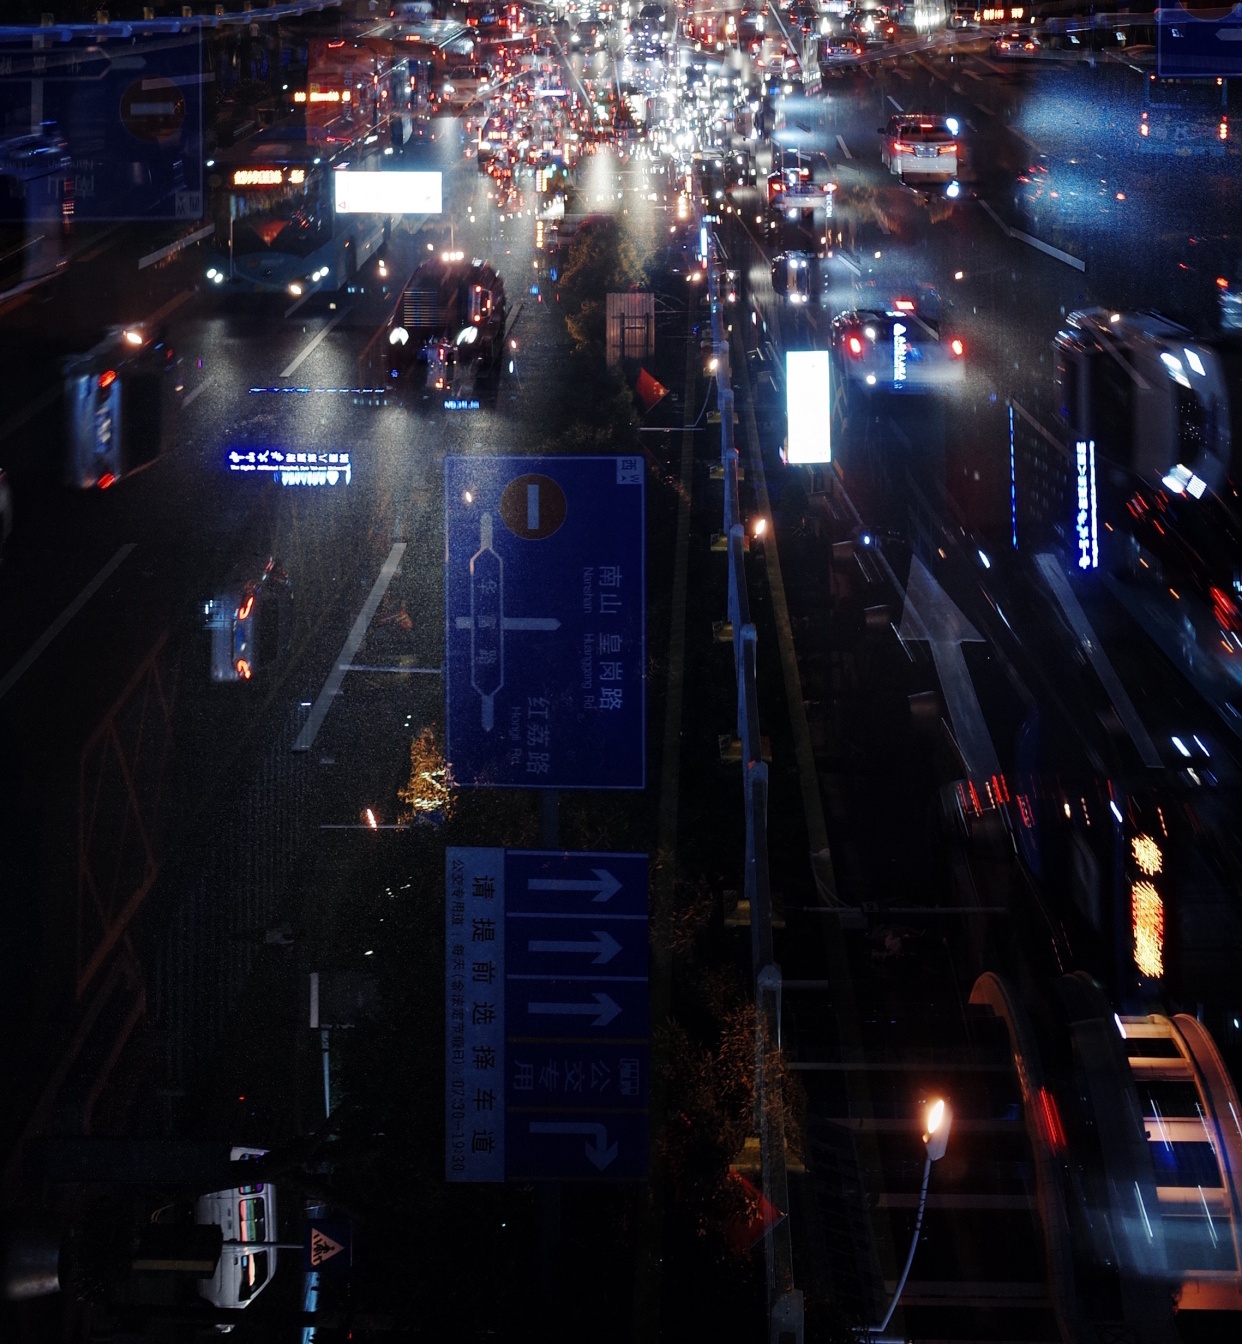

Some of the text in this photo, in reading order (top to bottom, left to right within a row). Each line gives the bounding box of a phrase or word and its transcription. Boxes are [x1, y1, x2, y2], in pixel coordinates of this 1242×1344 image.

[622, 459, 639, 483] 西 W
[581, 567, 594, 709] Nanshan Huanggang Rd
[598, 566, 622, 710] 南山 皇岗路
[509, 707, 522, 741] Hongli
[526, 697, 550, 774] 红荔路
[472, 876, 495, 1154] 请提前选择车道
[513, 1059, 610, 1093] 公交专用
